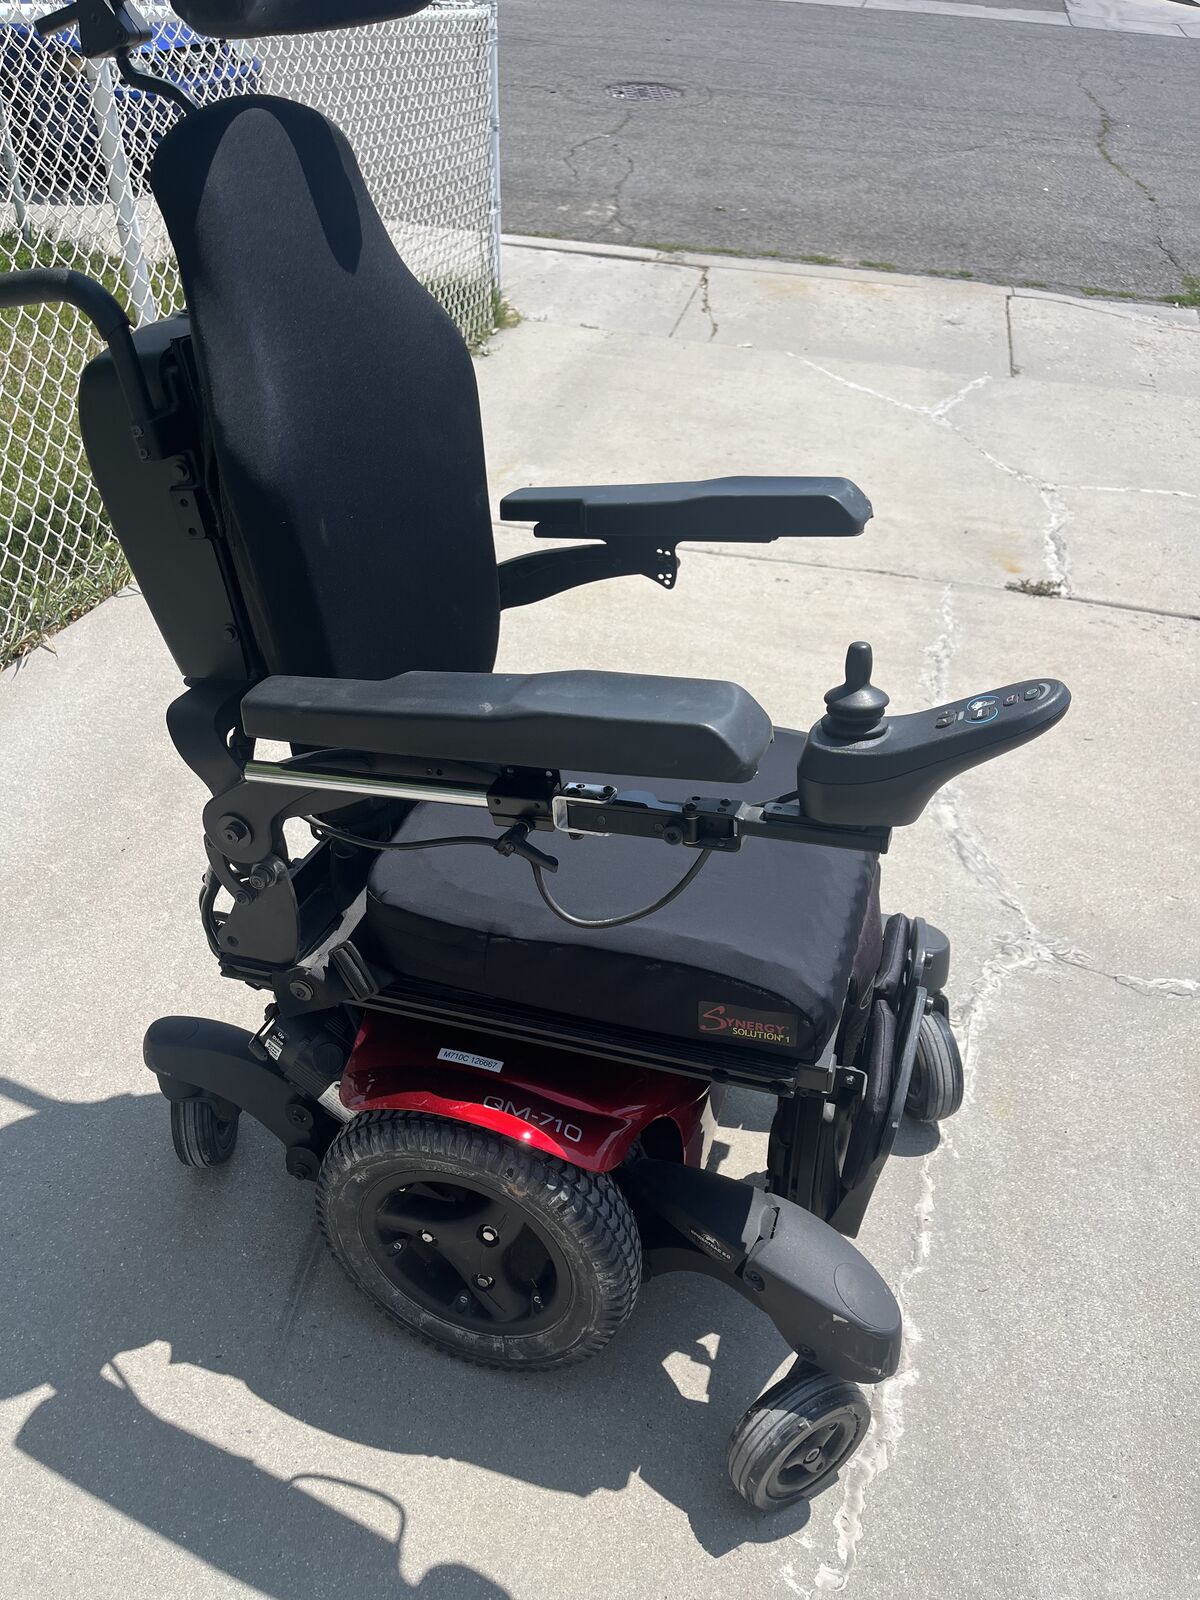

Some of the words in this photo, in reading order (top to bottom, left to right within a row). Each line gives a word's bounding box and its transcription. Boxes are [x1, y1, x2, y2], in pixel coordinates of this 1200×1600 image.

[700, 1005, 786, 1033] SYNERGY
[443, 1051, 470, 1062] M710C
[470, 1057, 498, 1069] 126667
[483, 1095, 583, 1143] QM-710
